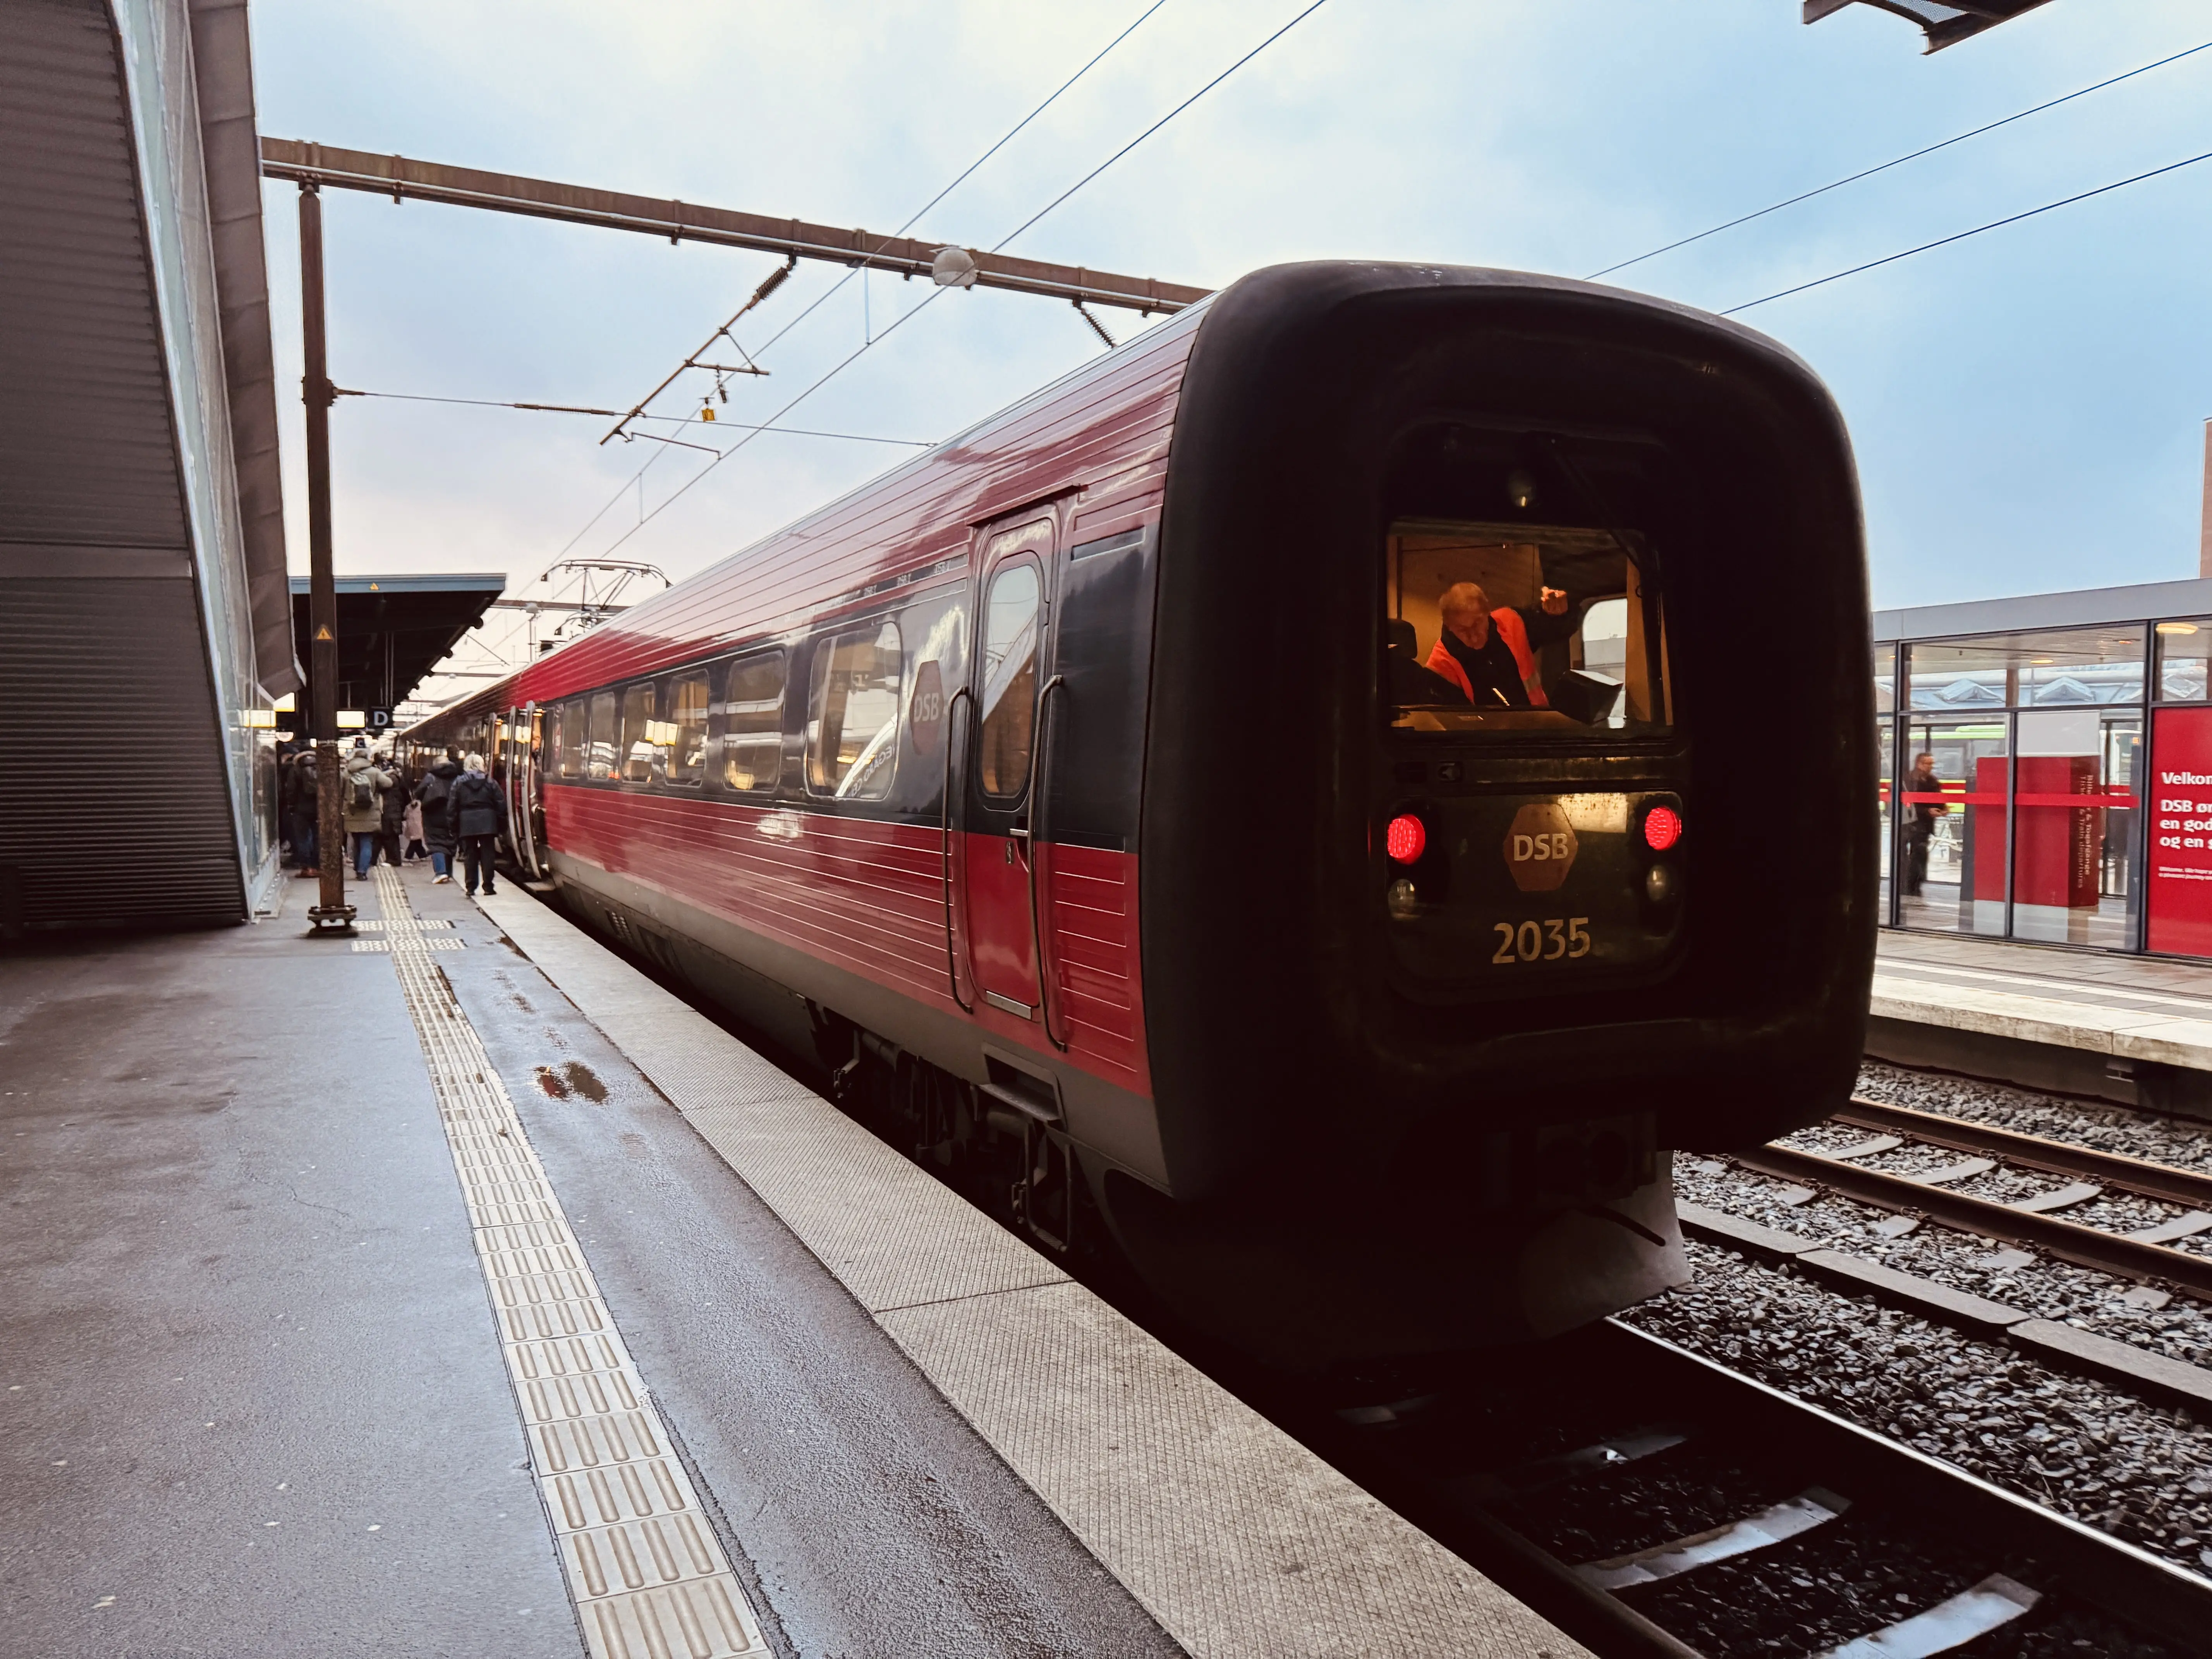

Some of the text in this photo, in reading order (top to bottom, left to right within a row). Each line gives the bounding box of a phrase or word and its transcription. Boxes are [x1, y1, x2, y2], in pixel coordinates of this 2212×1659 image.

[914, 692, 939, 722] DSB
[374, 711, 388, 726] D
[2160, 799, 2193, 812] DSB
[2159, 819, 2180, 830] en
[1513, 833, 1569, 861] DSB
[2159, 836, 2181, 849] og
[2183, 838, 2204, 848] en
[1492, 917, 1590, 964] 2035
